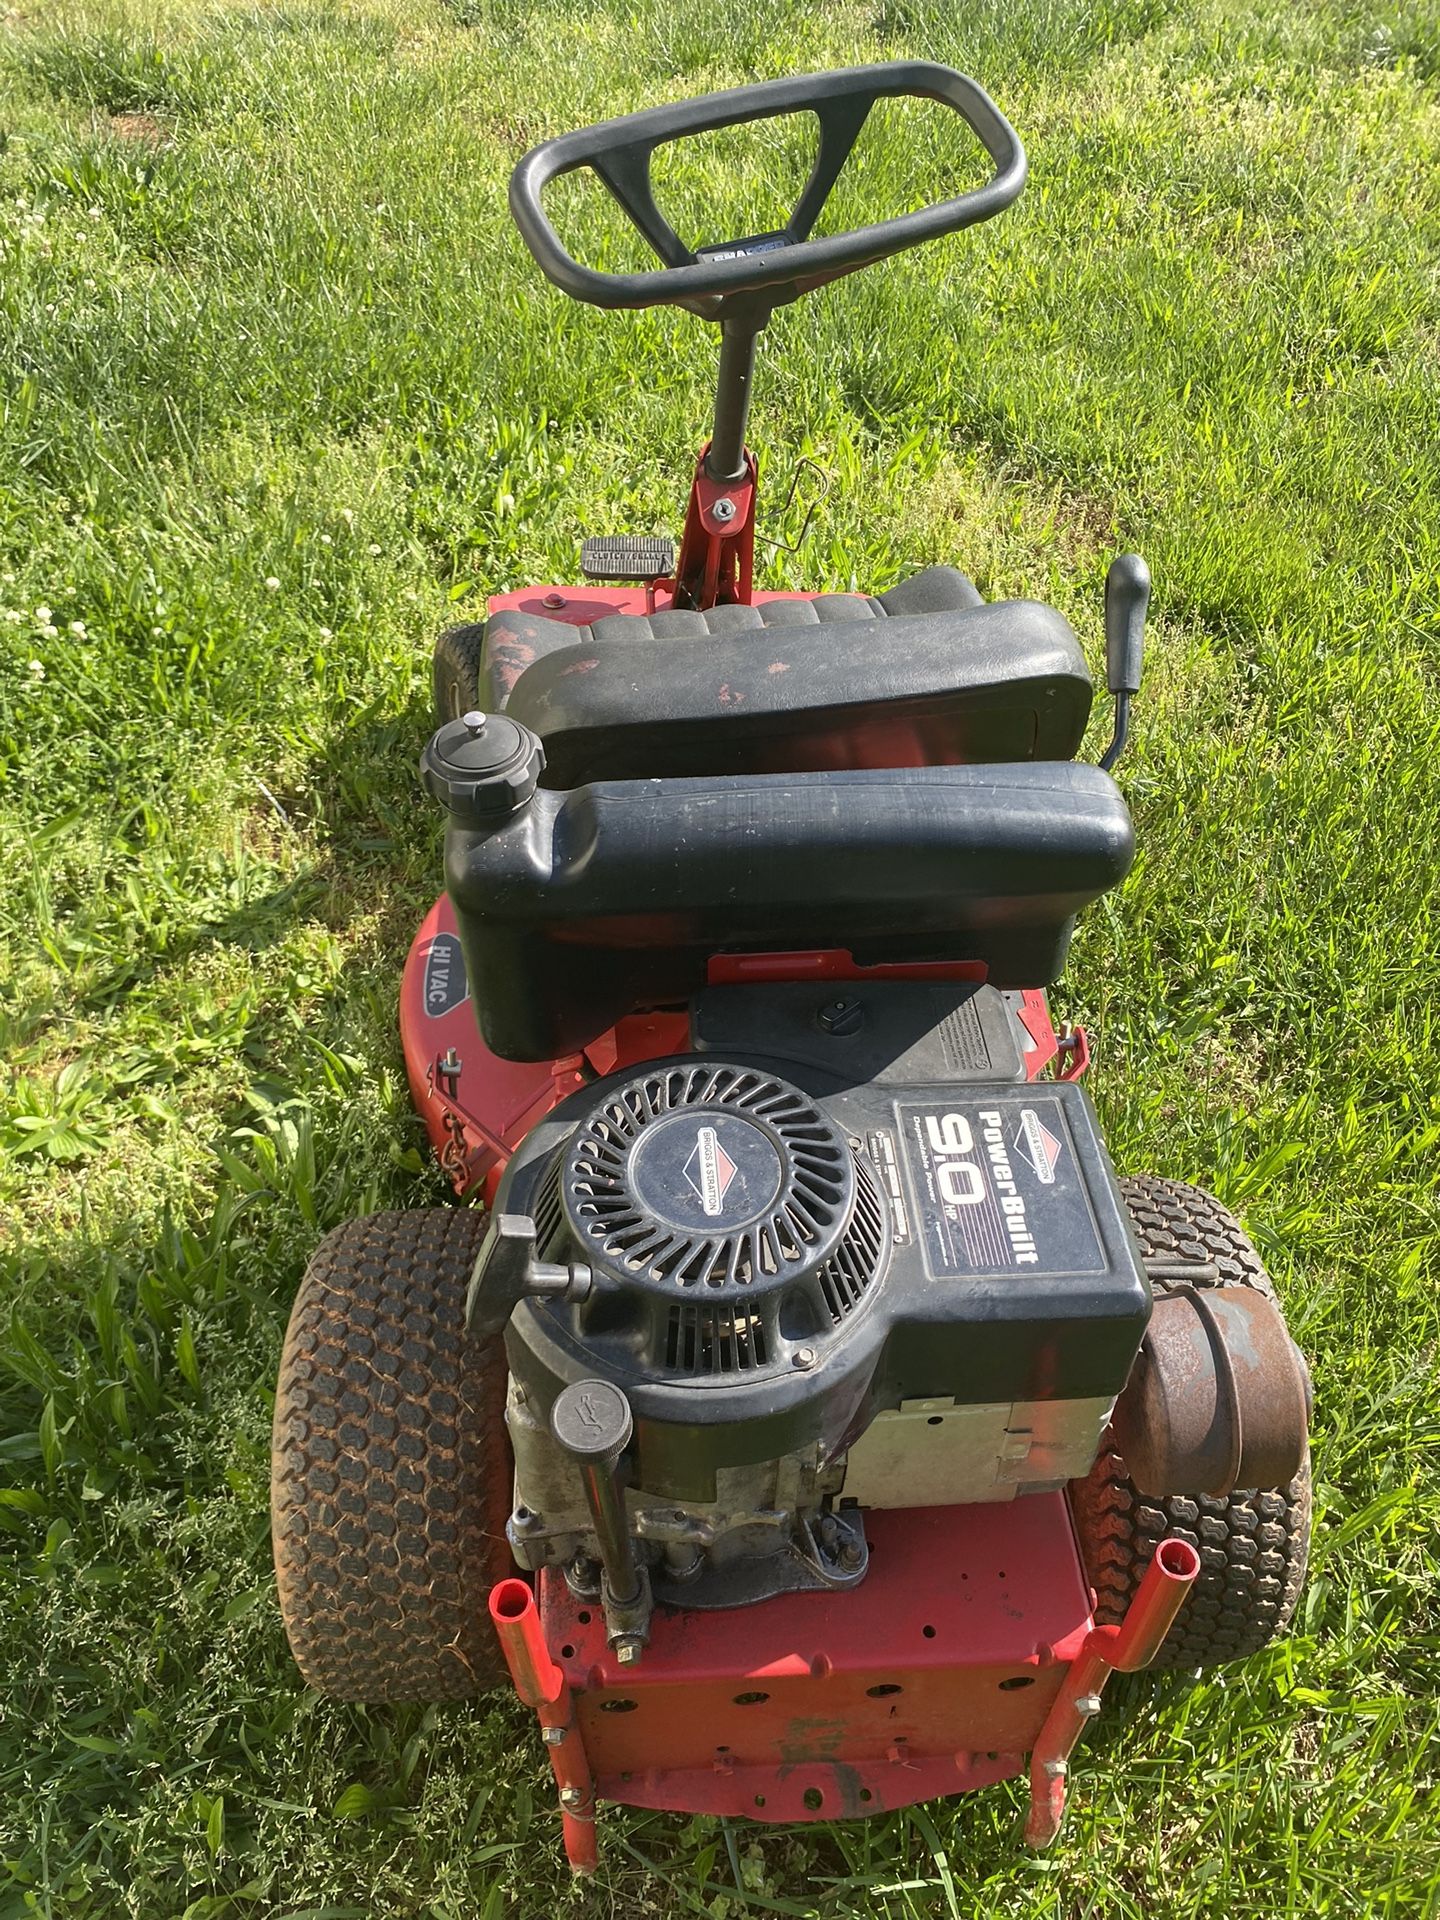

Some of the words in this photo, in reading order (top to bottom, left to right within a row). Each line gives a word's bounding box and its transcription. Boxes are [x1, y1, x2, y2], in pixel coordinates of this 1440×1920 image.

[433, 945, 451, 963] HI
[429, 968, 449, 1003] VAC
[703, 1132, 714, 1161] BRIGGS
[913, 1115, 930, 1169] Dependable
[925, 1171, 936, 1204] Power
[925, 1113, 986, 1205] 9.0
[1025, 1112, 1038, 1139] BRIGGS
[1034, 1143, 1050, 1180] STRATTON
[706, 1169, 718, 1211] STRATTON
[978, 1111, 1039, 1264] PowerBuilt
[944, 1204, 958, 1220] HP
